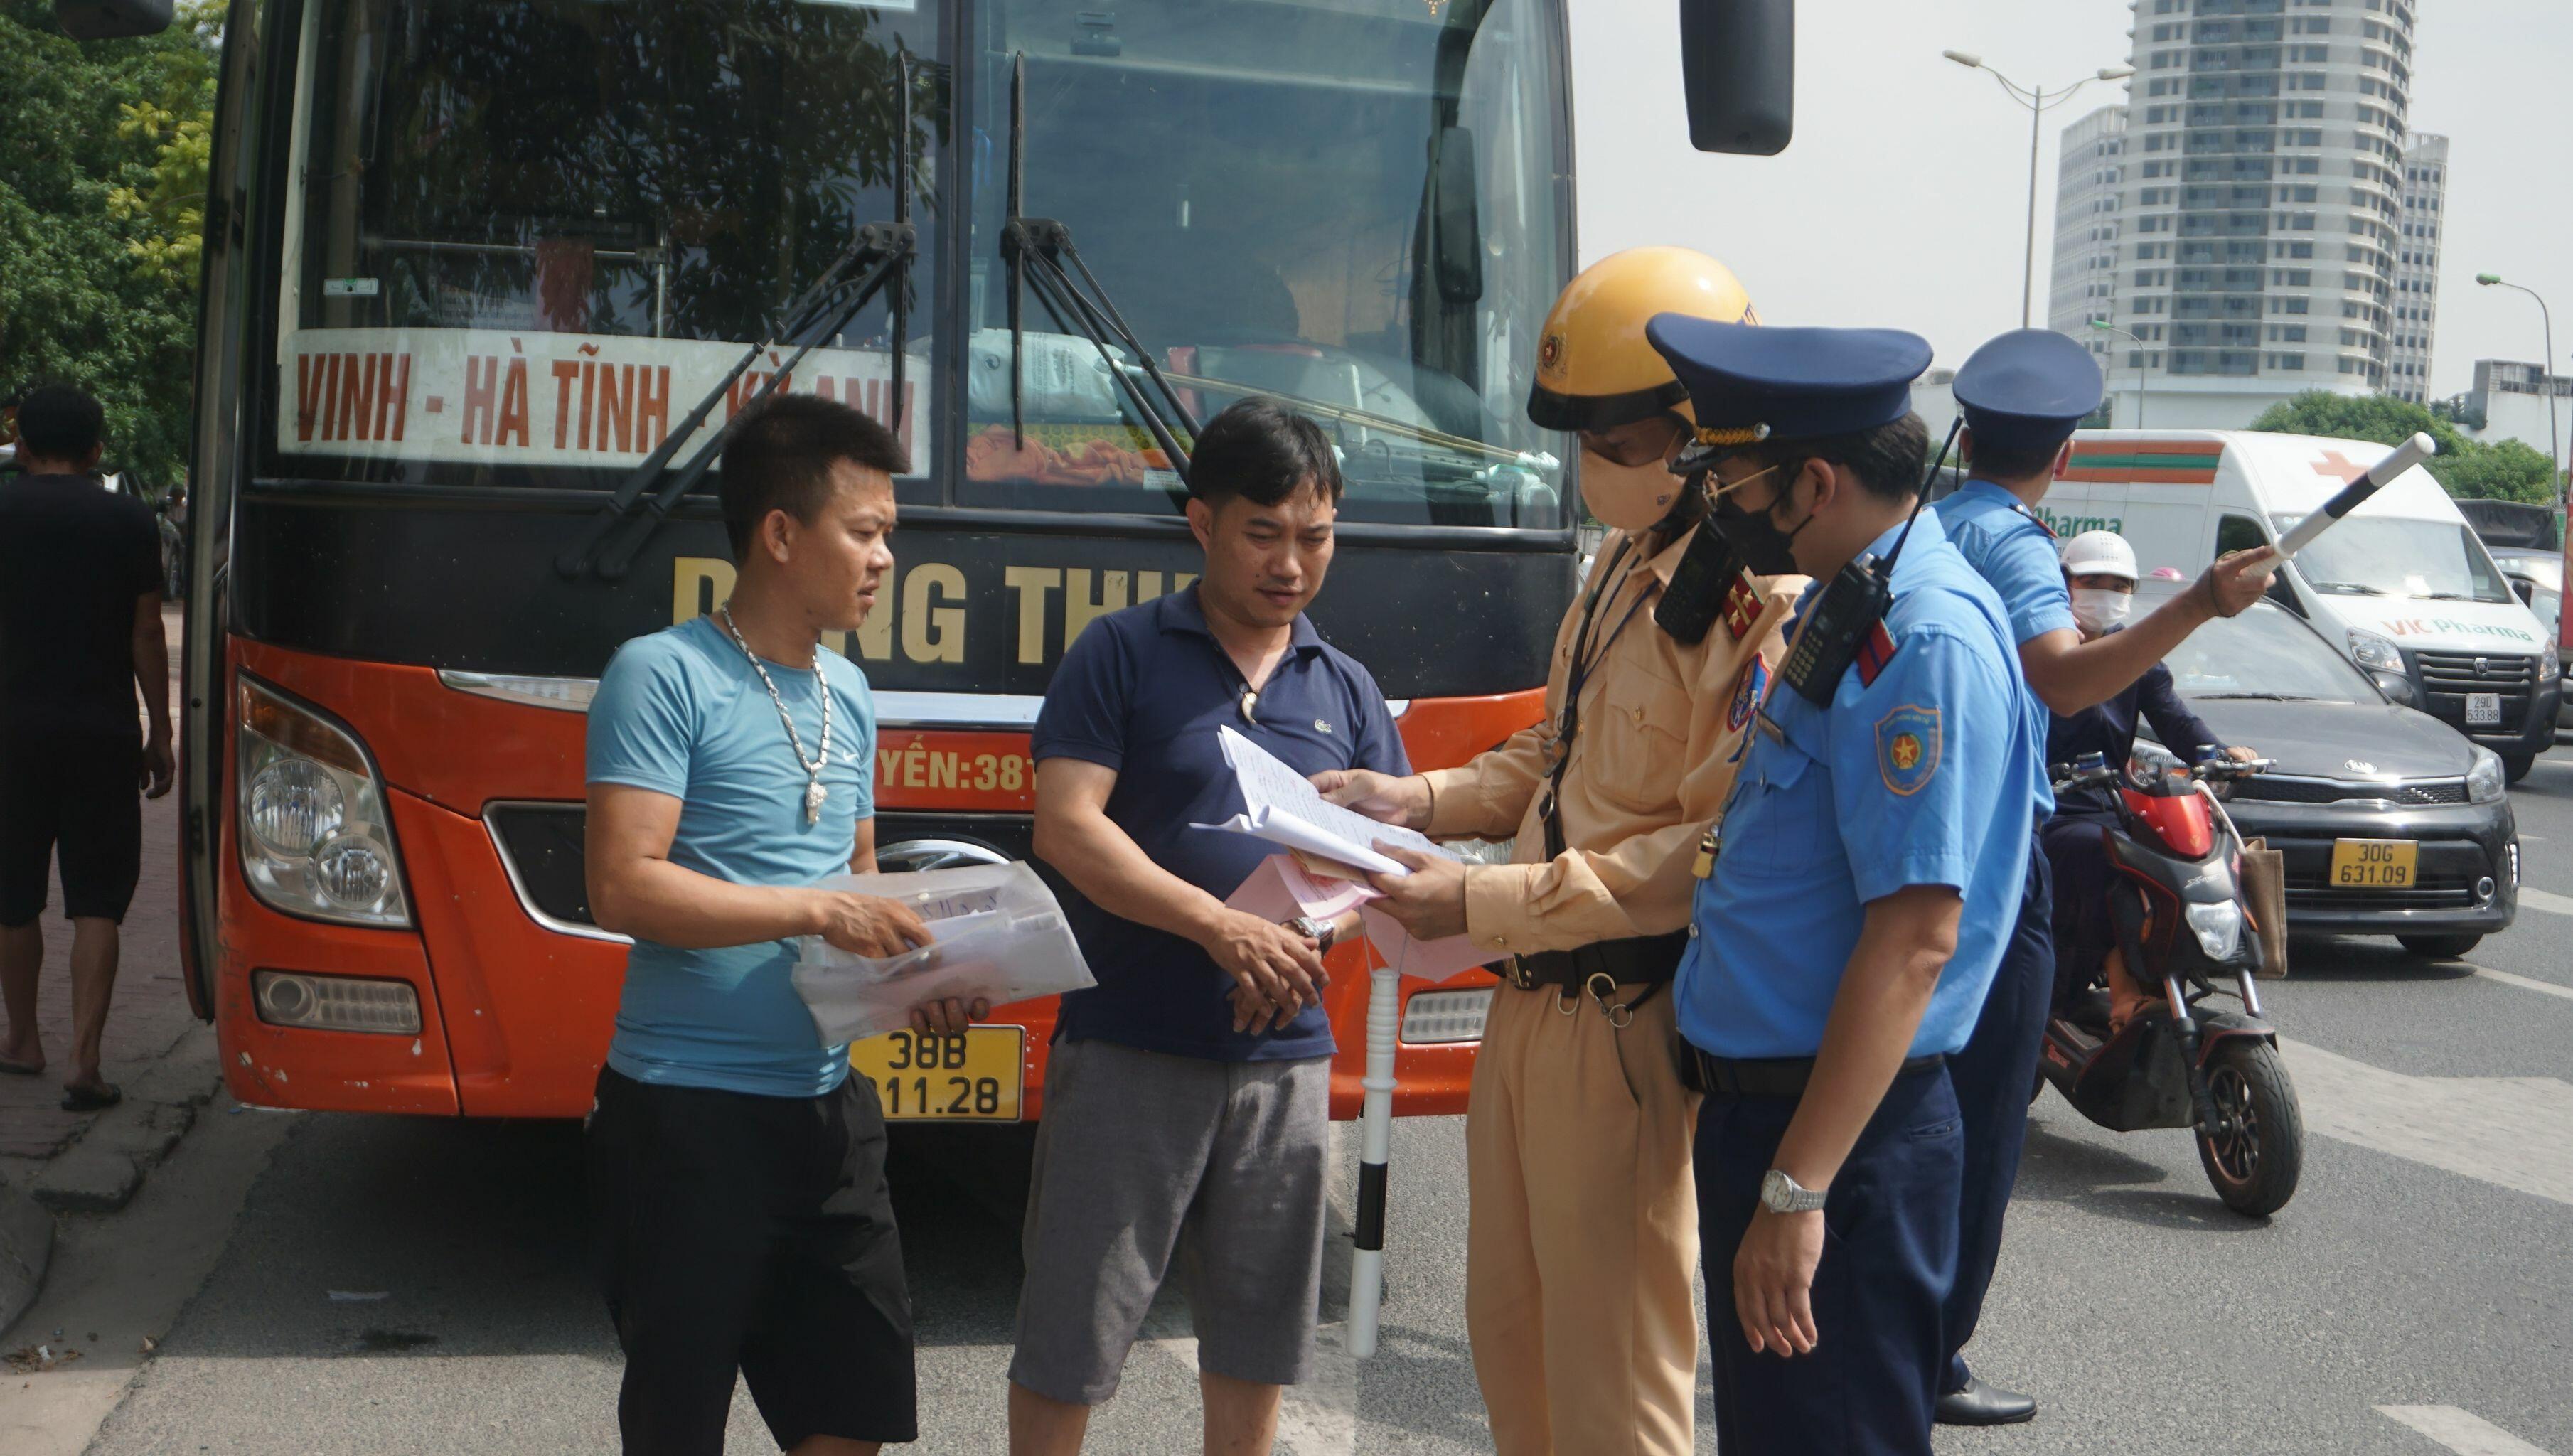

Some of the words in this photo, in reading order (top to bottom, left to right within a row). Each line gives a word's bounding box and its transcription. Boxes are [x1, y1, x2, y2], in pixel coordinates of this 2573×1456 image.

[297, 353, 410, 441] VINH
[460, 336, 530, 447] HÀ
[552, 342, 670, 454] TĨNH
[673, 556, 967, 663] DNG
[2379, 618, 2433, 636] VIC
[2474, 696, 2493, 709] 29D
[2358, 843, 2394, 862] 30G
[2340, 864, 2407, 884] 631.09
[888, 1031, 967, 1069] 38B
[864, 1076, 1000, 1114] 11.28
